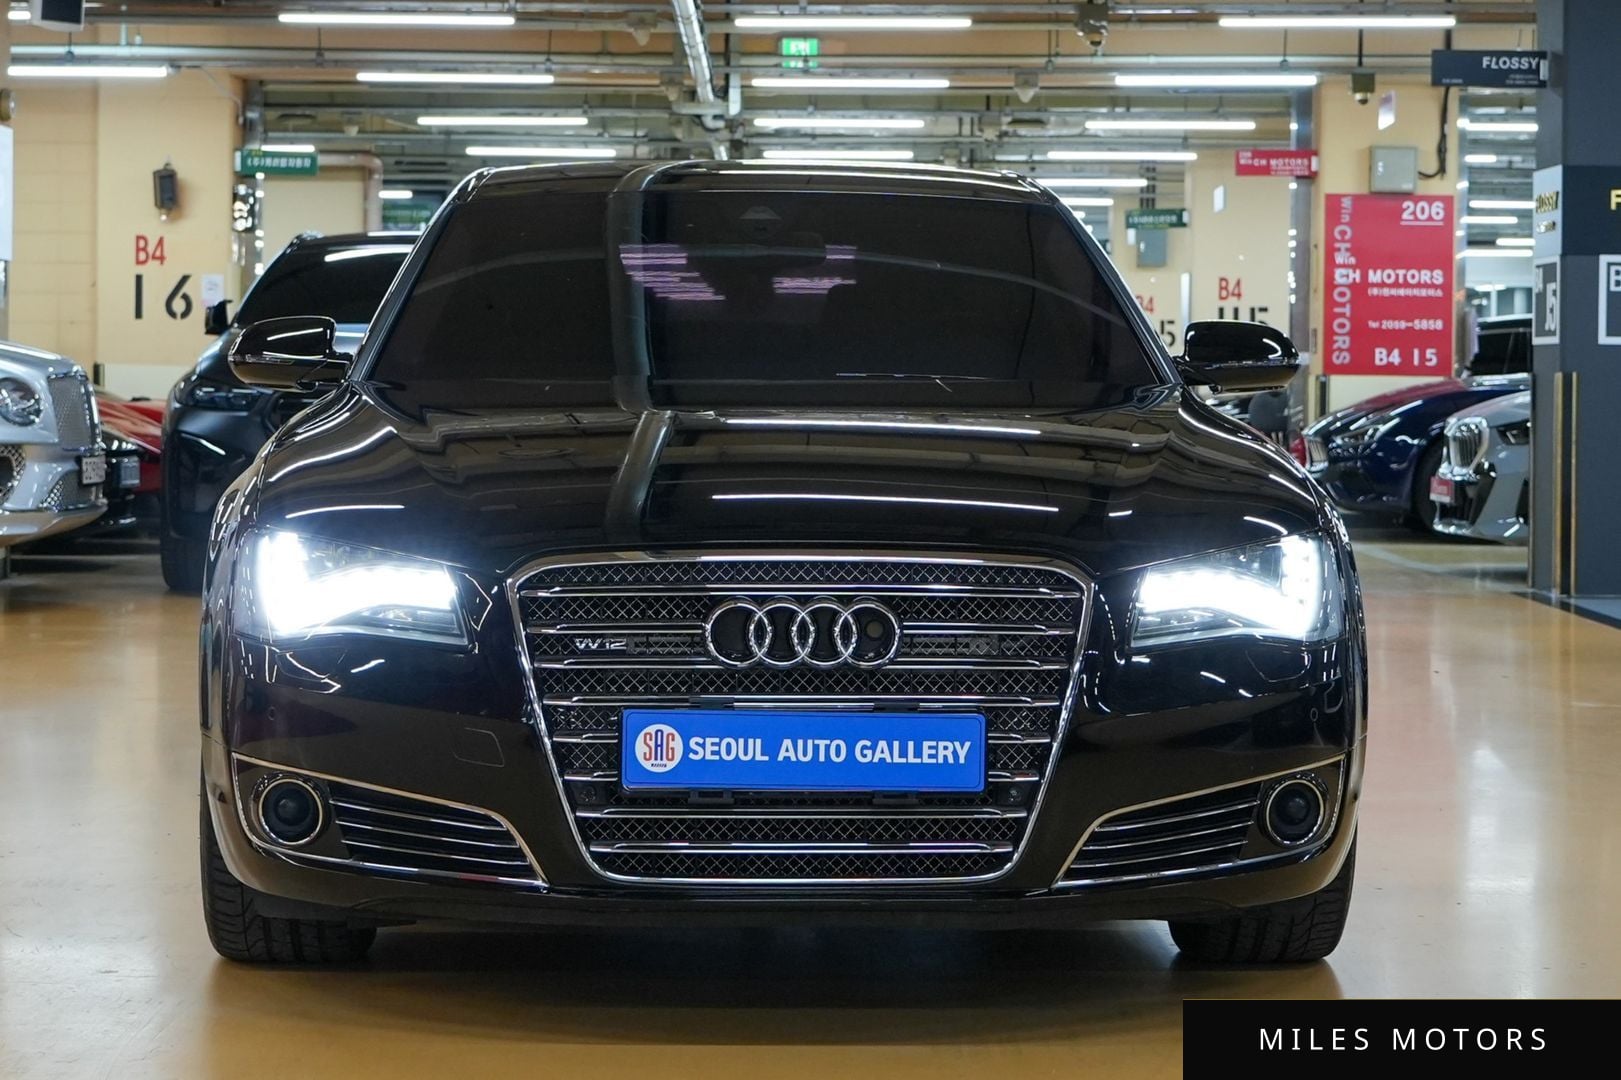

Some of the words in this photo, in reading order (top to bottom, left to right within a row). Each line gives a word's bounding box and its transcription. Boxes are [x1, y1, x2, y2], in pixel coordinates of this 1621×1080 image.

[1482, 56, 1539, 70] FLOSSY
[1401, 200, 1445, 221] 206
[135, 235, 167, 266] B4
[1335, 252, 1357, 265] Win
[1368, 268, 1444, 285] MOTORS
[1218, 277, 1242, 301] B4
[1374, 347, 1401, 366] B4
[574, 638, 627, 650] W12
[643, 729, 676, 762] SAG
[688, 736, 769, 761] SEOUL
[777, 739, 847, 763] AUTO
[854, 740, 972, 764] GALLERY
